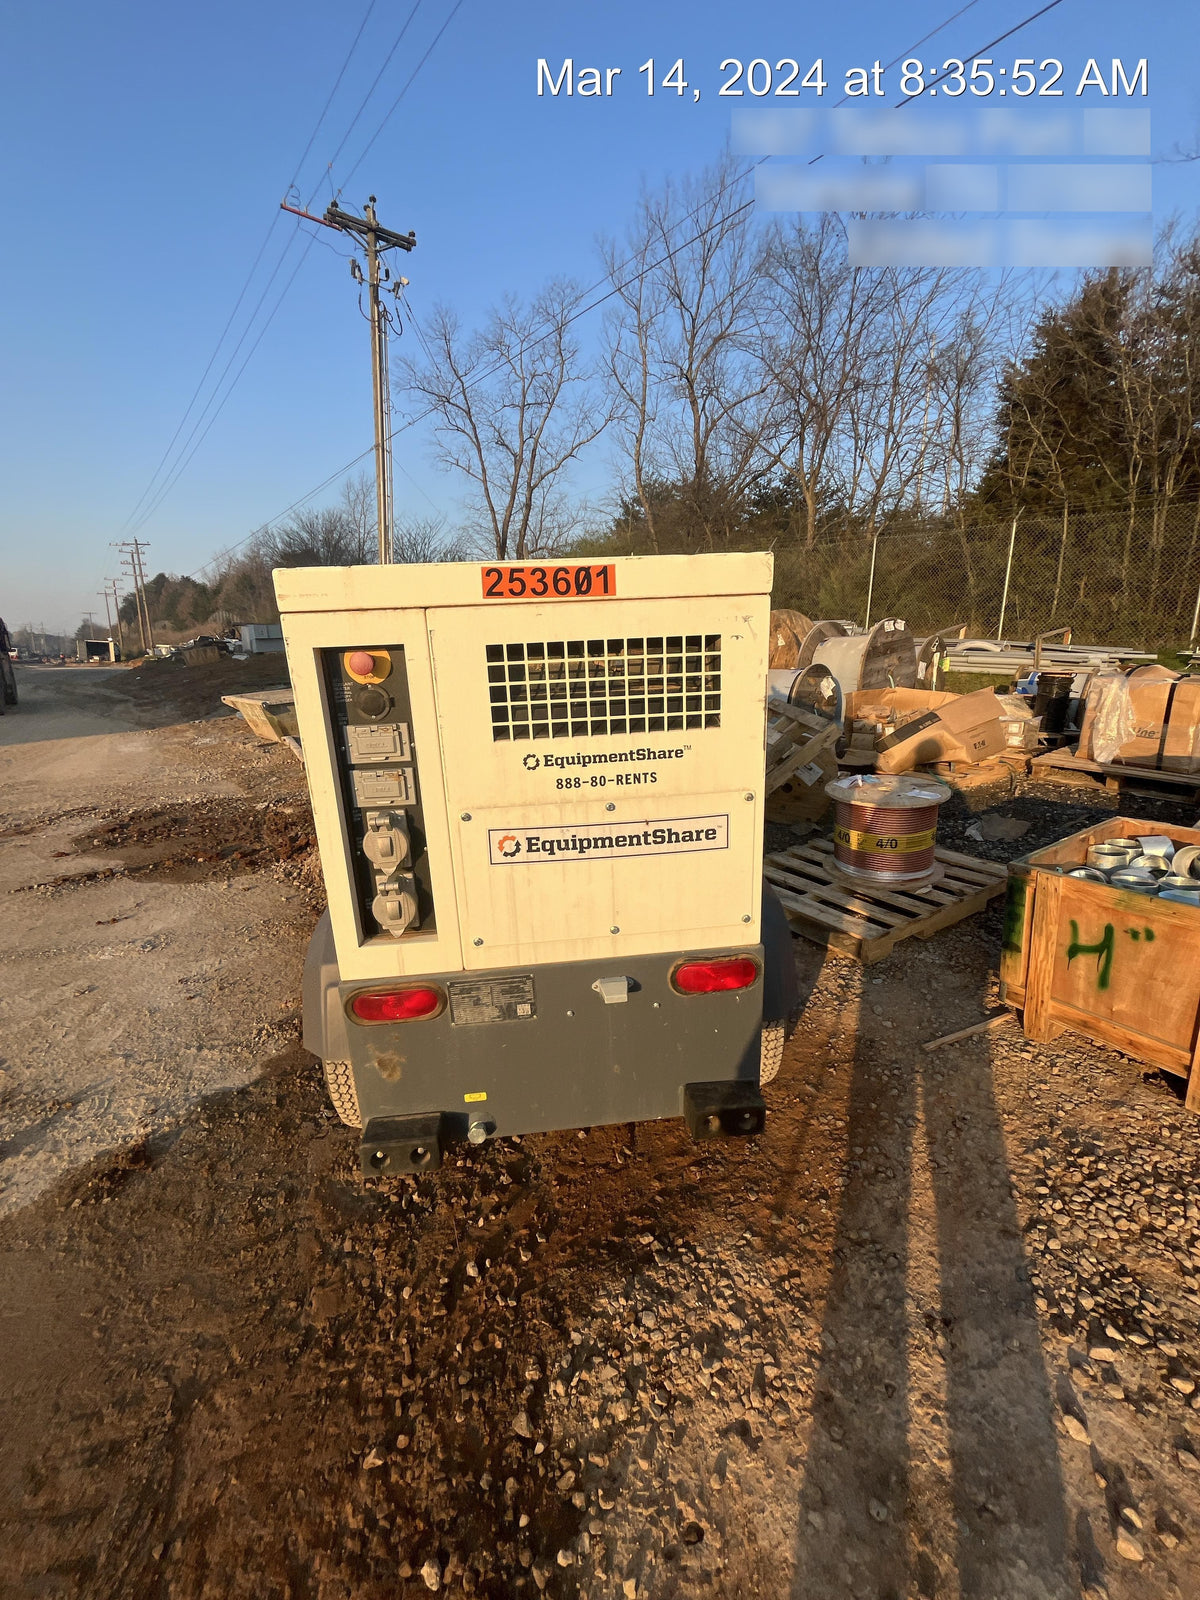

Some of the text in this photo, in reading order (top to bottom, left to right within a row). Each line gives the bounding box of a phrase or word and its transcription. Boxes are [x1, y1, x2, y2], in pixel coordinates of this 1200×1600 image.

[485, 565, 609, 597] 253601
[556, 771, 658, 790] 888-80-RENTS
[875, 838, 898, 850] 4/0
